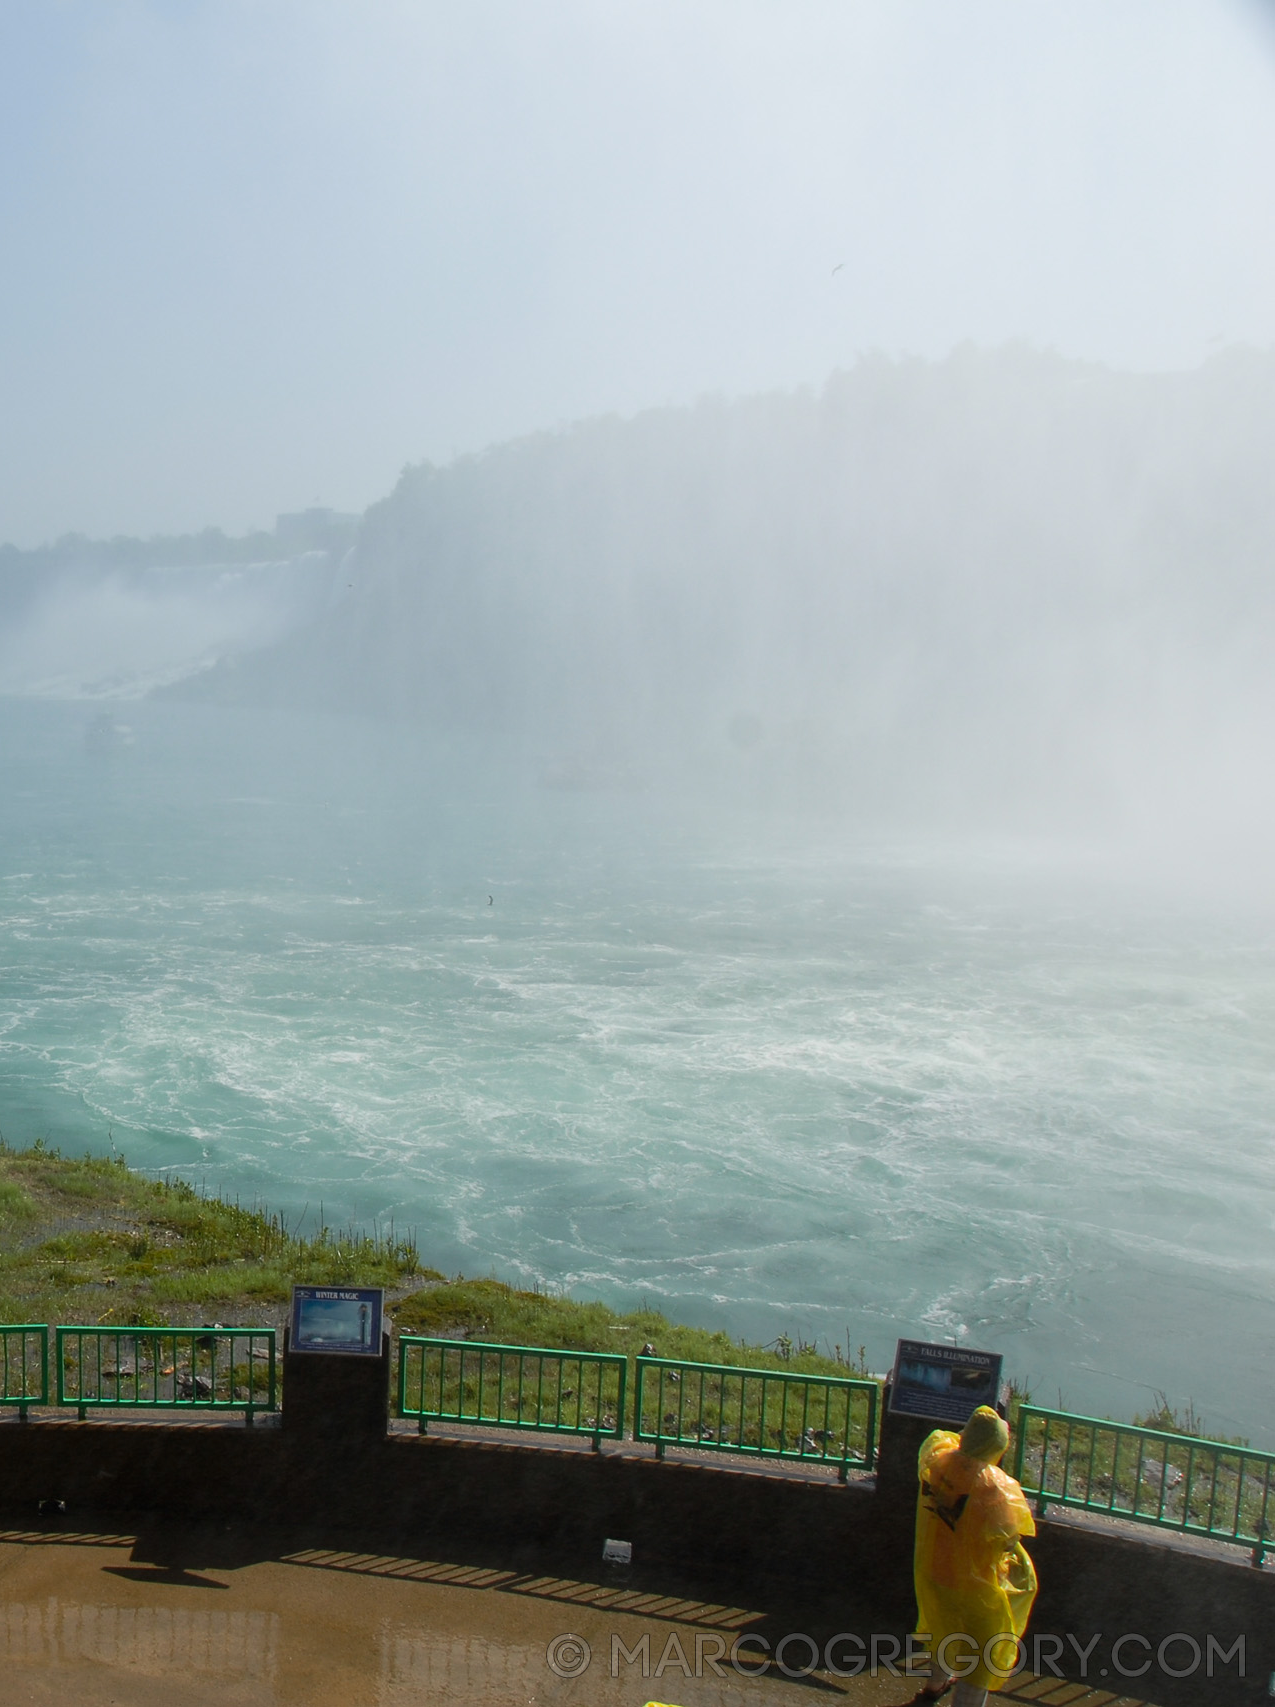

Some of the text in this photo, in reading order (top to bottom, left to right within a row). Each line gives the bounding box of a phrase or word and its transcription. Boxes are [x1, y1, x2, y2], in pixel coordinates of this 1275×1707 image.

[316, 1291, 338, 1299] WINTER
[339, 1292, 360, 1300] MAGIC
[920, 1348, 990, 1364] FALLS ILLUMINATION
